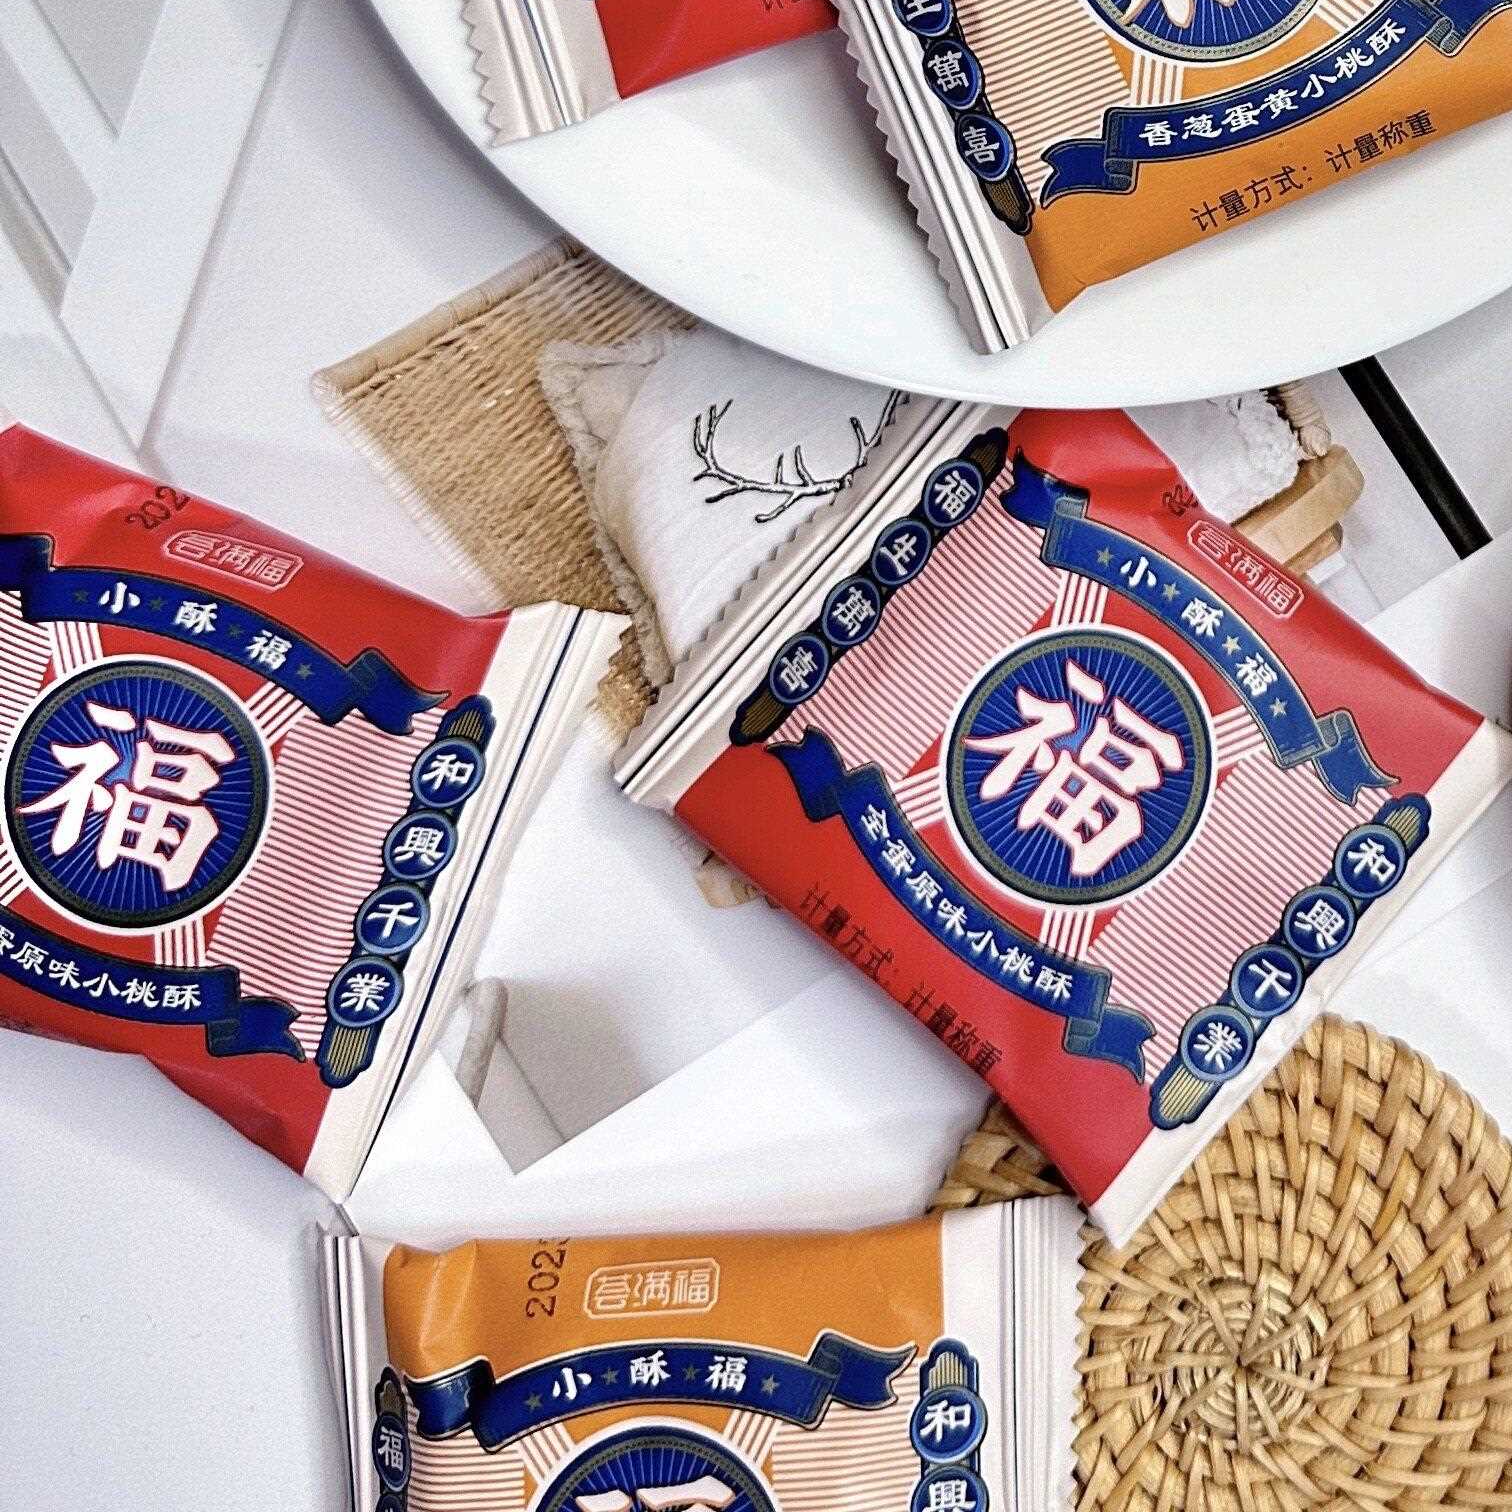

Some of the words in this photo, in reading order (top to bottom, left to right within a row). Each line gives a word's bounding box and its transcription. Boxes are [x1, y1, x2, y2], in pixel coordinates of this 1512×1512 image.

[1140, 18, 1406, 150] 香葱蛋黄小桃酥
[98, 581, 294, 669] 小酥福
[781, 470, 980, 693] 福生萬喜
[1119, 555, 1274, 695] 小酥福
[22, 703, 237, 890] 福
[965, 660, 1185, 876] 福
[341, 752, 473, 1011] 和興千業
[857, 803, 1072, 1001] 全蛋原味小桃酥
[1196, 838, 1395, 1068] 和興千業
[551, 1355, 748, 1399] 小酥福
